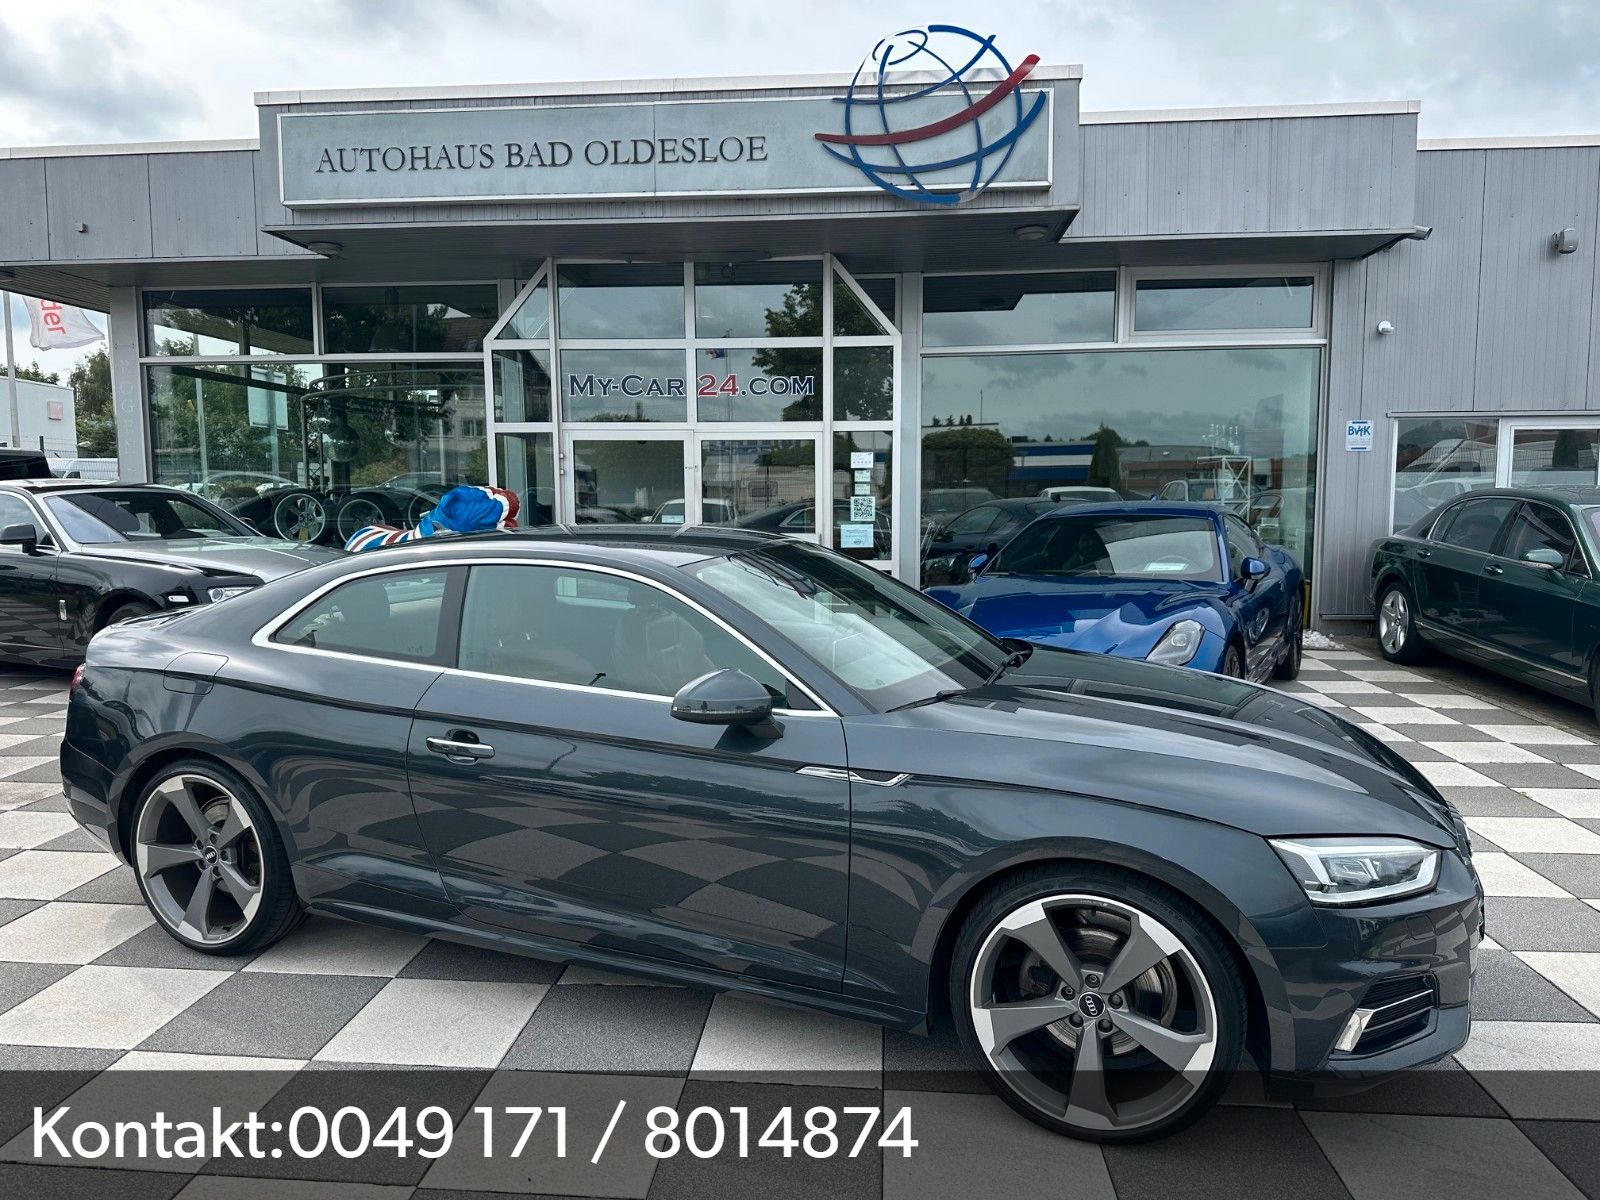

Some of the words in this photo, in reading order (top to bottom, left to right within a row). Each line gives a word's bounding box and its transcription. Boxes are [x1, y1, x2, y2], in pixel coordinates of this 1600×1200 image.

[315, 143, 494, 173] AUTOHAUS
[504, 141, 573, 168] BAD
[584, 136, 768, 166] OLDESLOE
